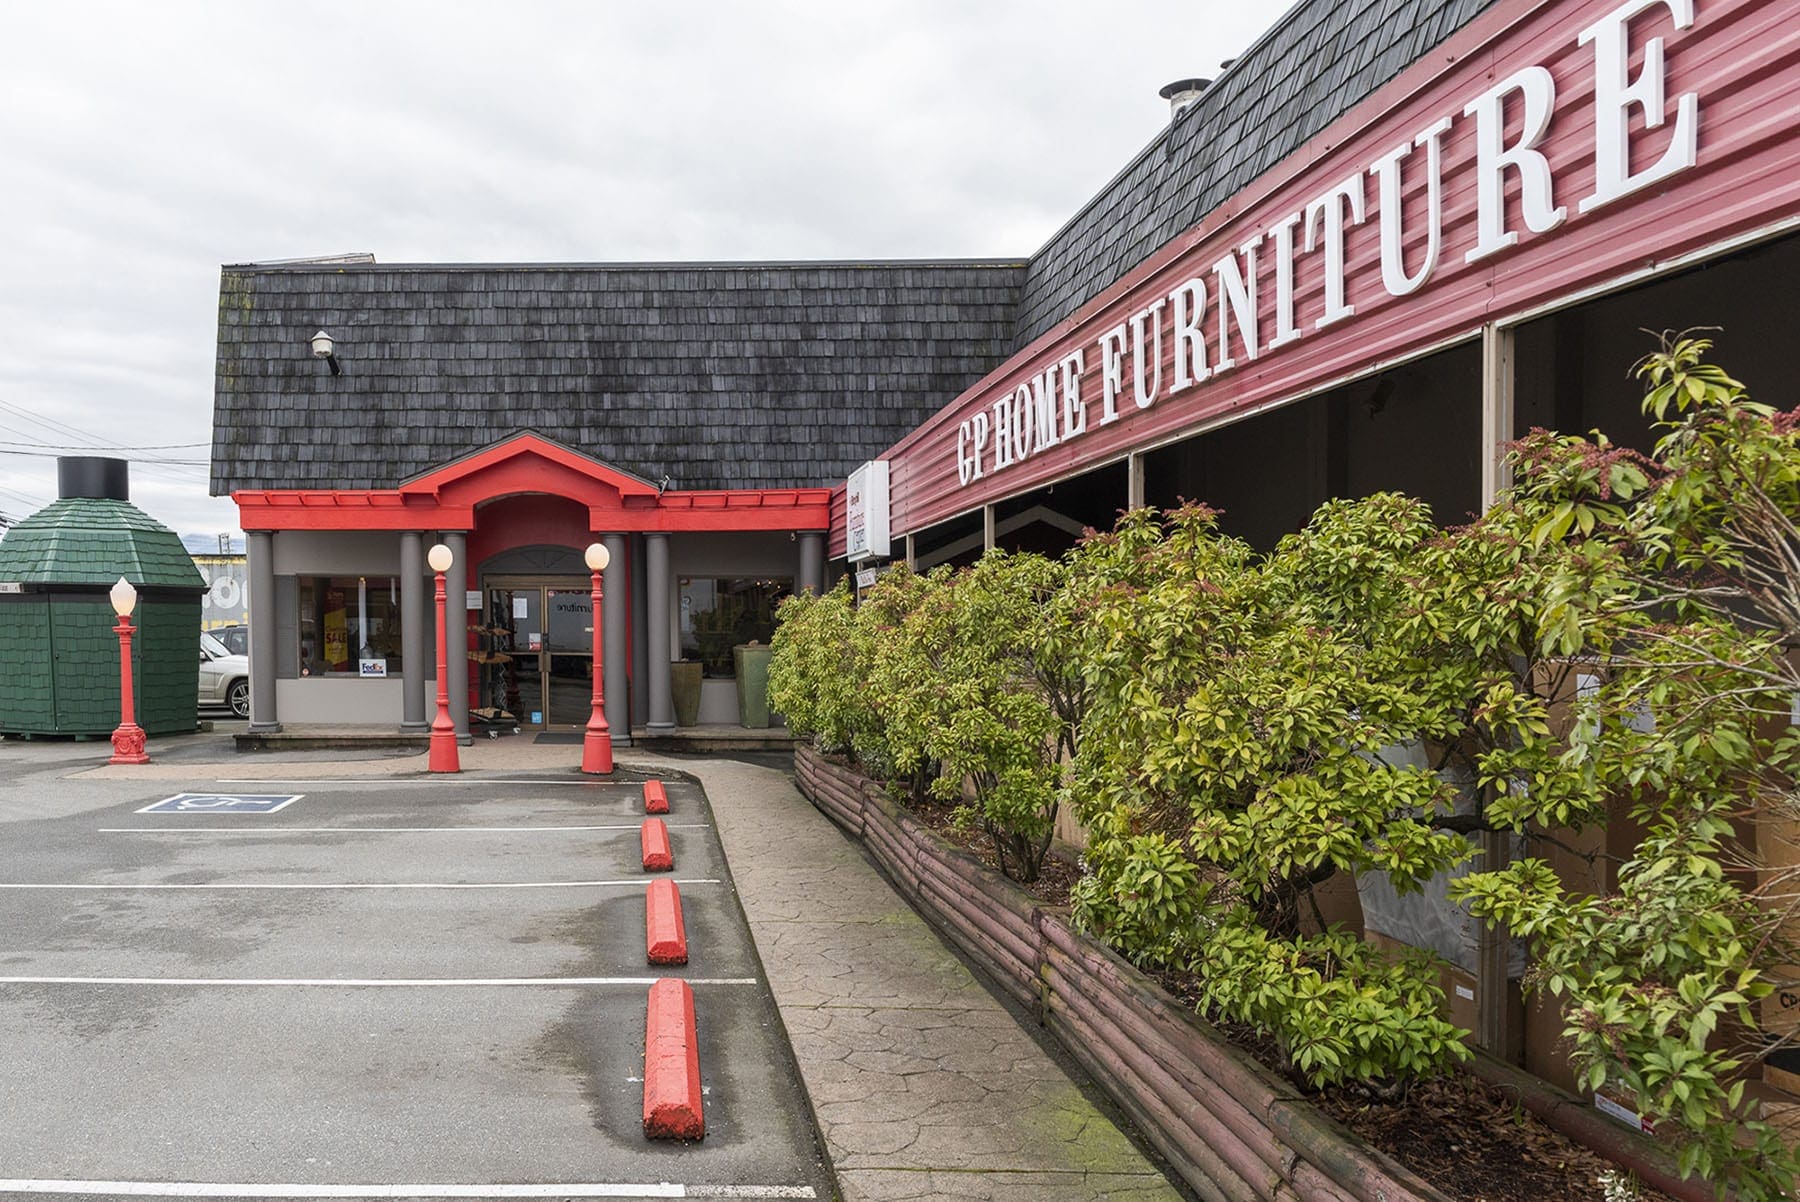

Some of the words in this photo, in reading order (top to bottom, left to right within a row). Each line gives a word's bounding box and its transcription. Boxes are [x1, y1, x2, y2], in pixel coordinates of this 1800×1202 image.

[956, 411, 990, 487] GP
[992, 348, 1088, 473] HOME
[1098, 0, 1697, 427] FURNITURE
[326, 632, 347, 644] SALE
